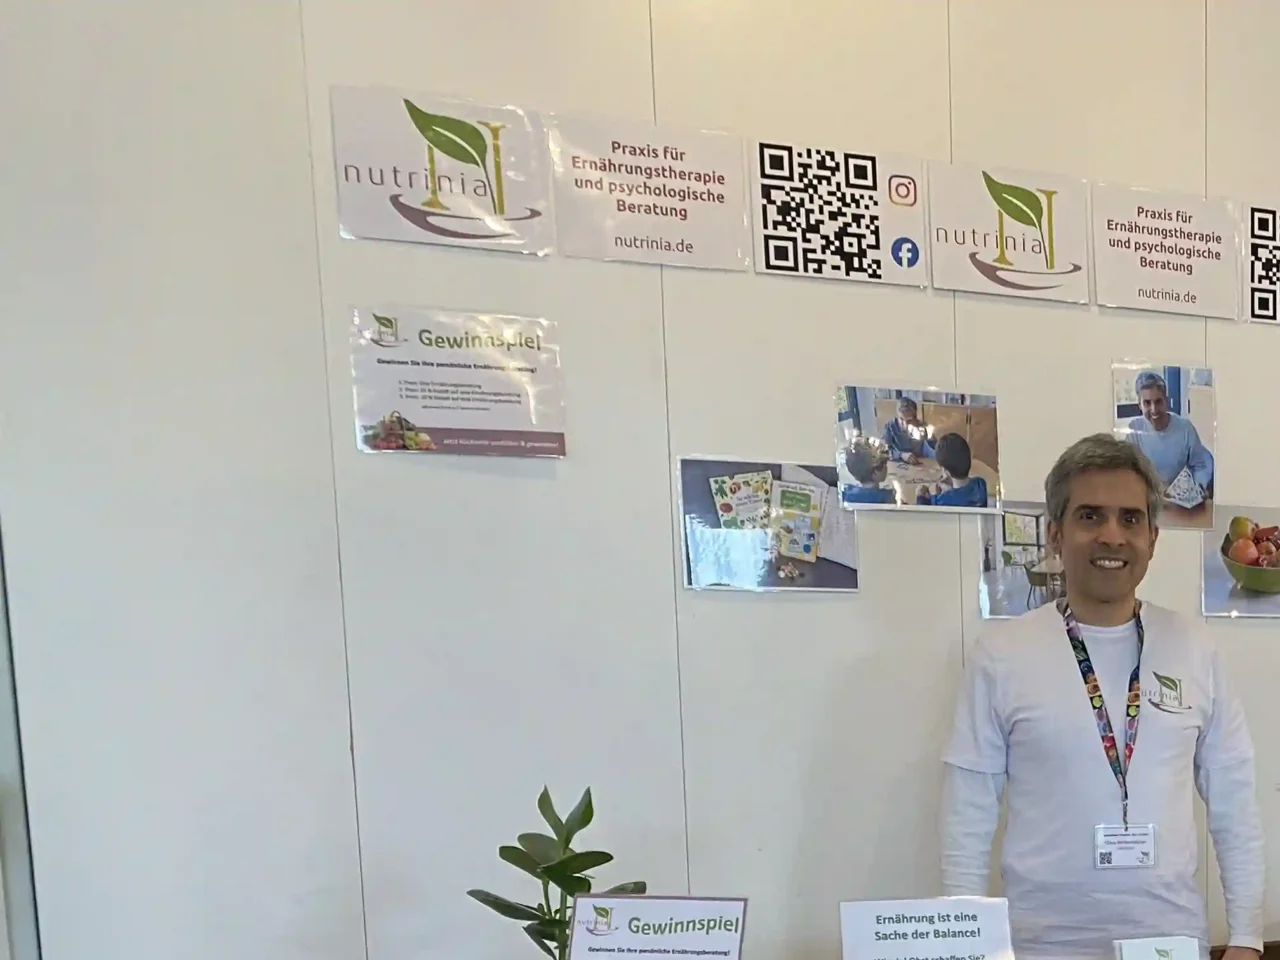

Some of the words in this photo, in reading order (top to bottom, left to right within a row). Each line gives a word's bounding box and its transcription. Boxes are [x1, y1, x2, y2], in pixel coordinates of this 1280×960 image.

[611, 141, 658, 161] Praxis
[662, 145, 687, 162] für
[344, 162, 489, 198] nutrinia
[571, 156, 726, 187] Ernährungstherapie
[574, 175, 603, 192] und
[608, 179, 725, 204] psychologische
[616, 199, 688, 221] Beratung
[1137, 206, 1172, 222] Praxis
[1175, 210, 1194, 224] für
[936, 226, 1043, 255] nutrinia
[1106, 219, 1222, 246] Ernährungstherapie
[614, 234, 694, 254] nutrinia.de
[1109, 237, 1130, 250] und
[1134, 239, 1221, 261] psychologische
[1139, 257, 1193, 275] Beratung
[1138, 287, 1197, 304] nutrinia.de
[418, 329, 542, 352] Gewinnspiel
[628, 916, 740, 936] Gewinnspiel
[876, 912, 935, 926] Ernährung
[937, 913, 952, 923] ist
[953, 912, 978, 923] eine
[874, 930, 909, 942] Sache
[911, 929, 931, 940] der
[933, 927, 982, 939] Balance!
